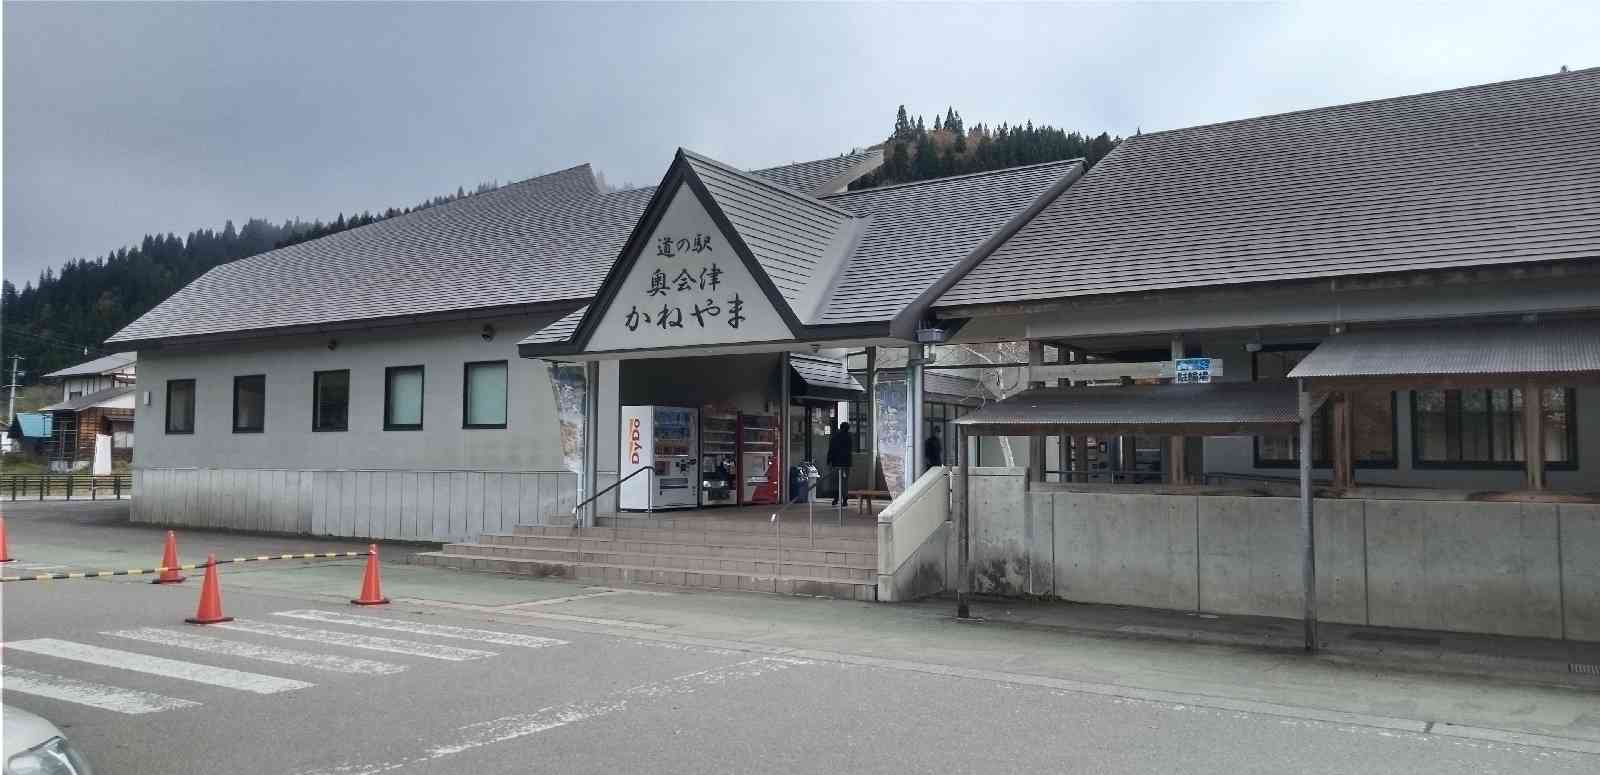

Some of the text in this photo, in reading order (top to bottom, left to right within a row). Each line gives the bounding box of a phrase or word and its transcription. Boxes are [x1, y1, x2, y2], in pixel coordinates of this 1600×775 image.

[656, 234, 713, 258] 道の駅
[647, 263, 724, 297] 奥会津
[625, 293, 746, 331] かねやま
[631, 418, 643, 465] DyDo
